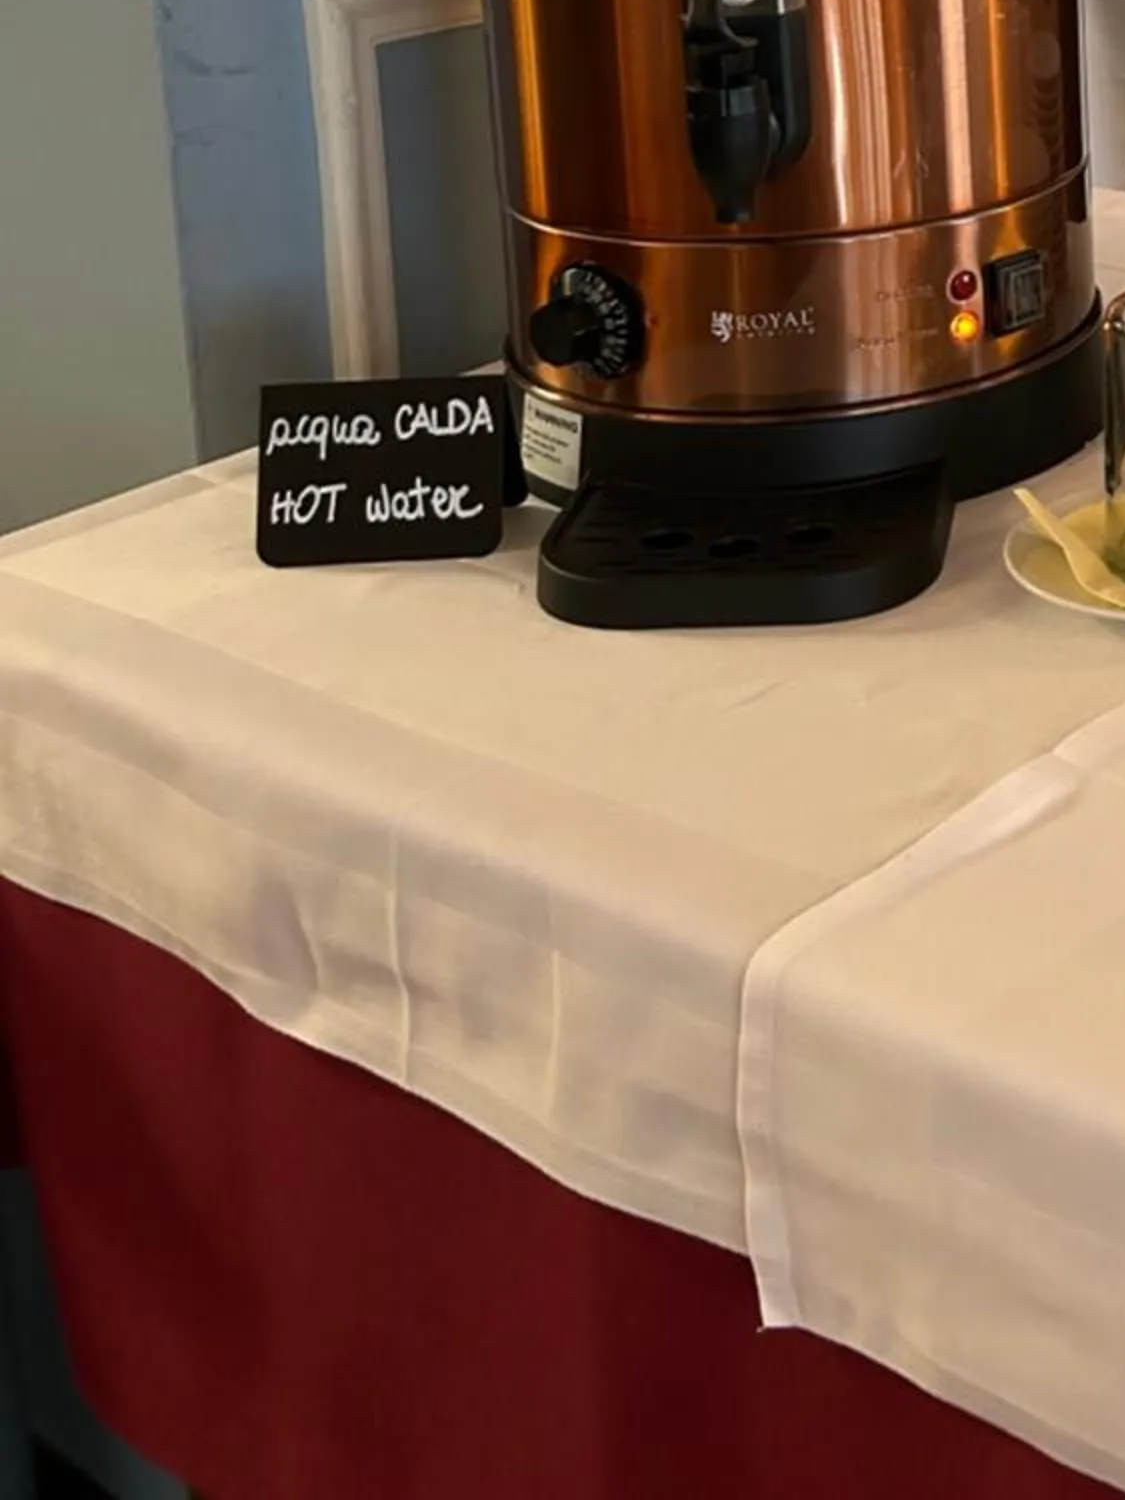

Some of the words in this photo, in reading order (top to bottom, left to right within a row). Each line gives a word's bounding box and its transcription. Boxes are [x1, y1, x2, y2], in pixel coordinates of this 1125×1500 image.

[735, 308, 815, 332] ROYAL
[394, 396, 494, 440] CALDA
[270, 483, 348, 525] HOT
